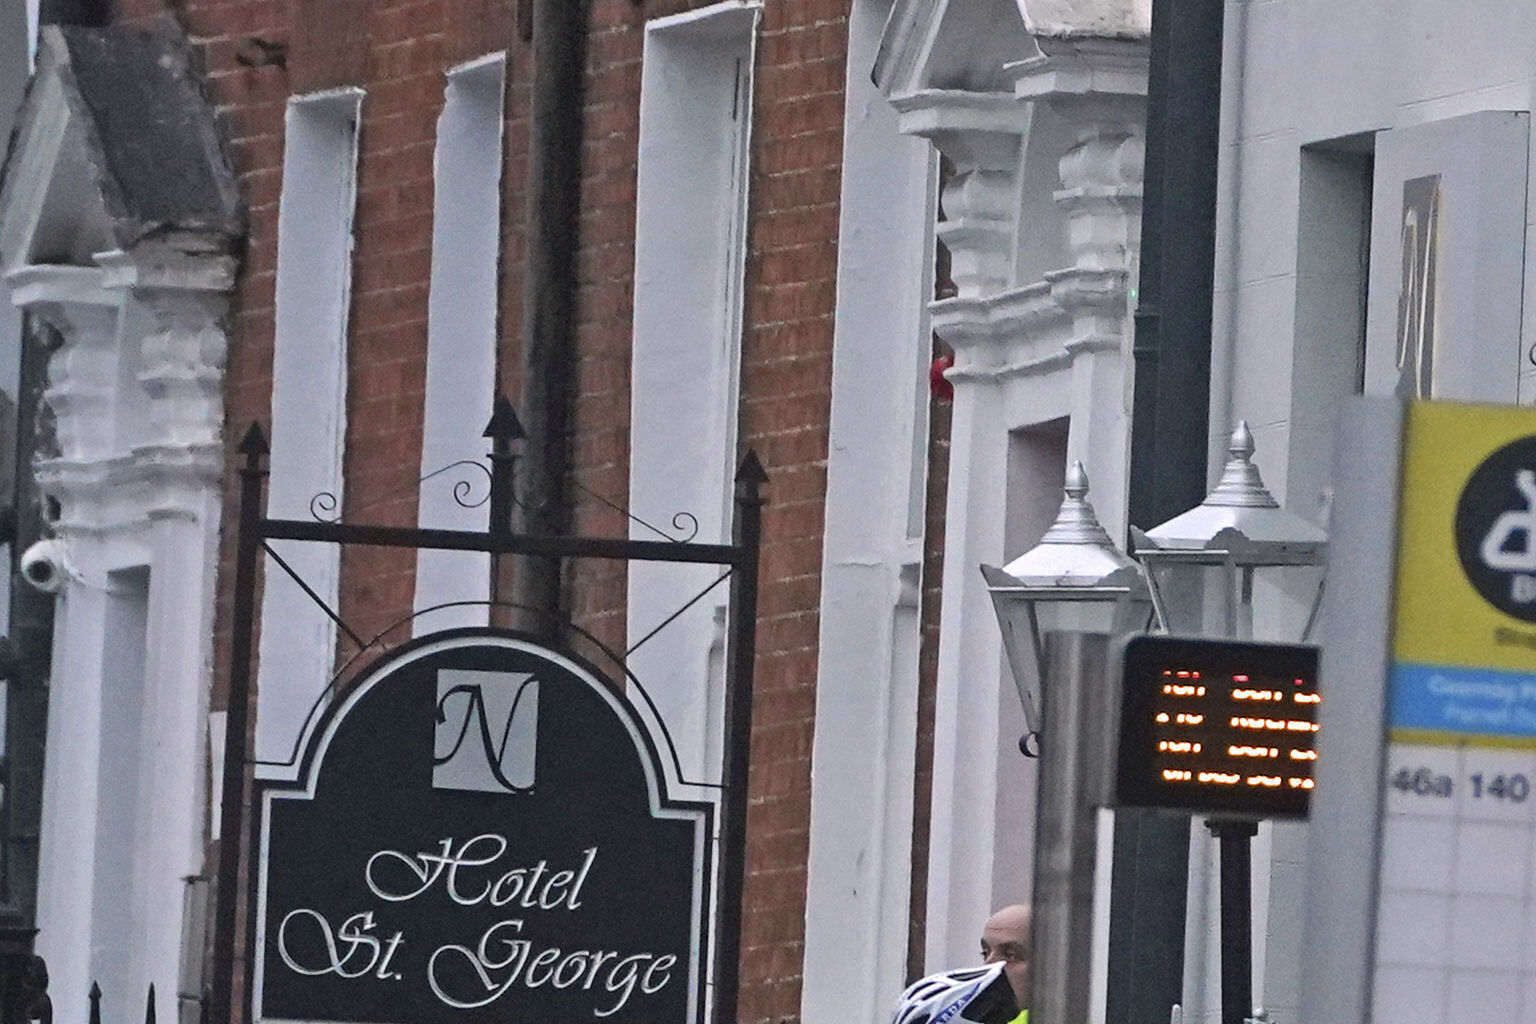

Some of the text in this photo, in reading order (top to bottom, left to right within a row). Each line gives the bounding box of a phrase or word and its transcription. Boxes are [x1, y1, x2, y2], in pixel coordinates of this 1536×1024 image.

[1470, 772, 1530, 803] 140
[365, 833, 598, 910] Hotel
[277, 908, 677, 1017] St. George
